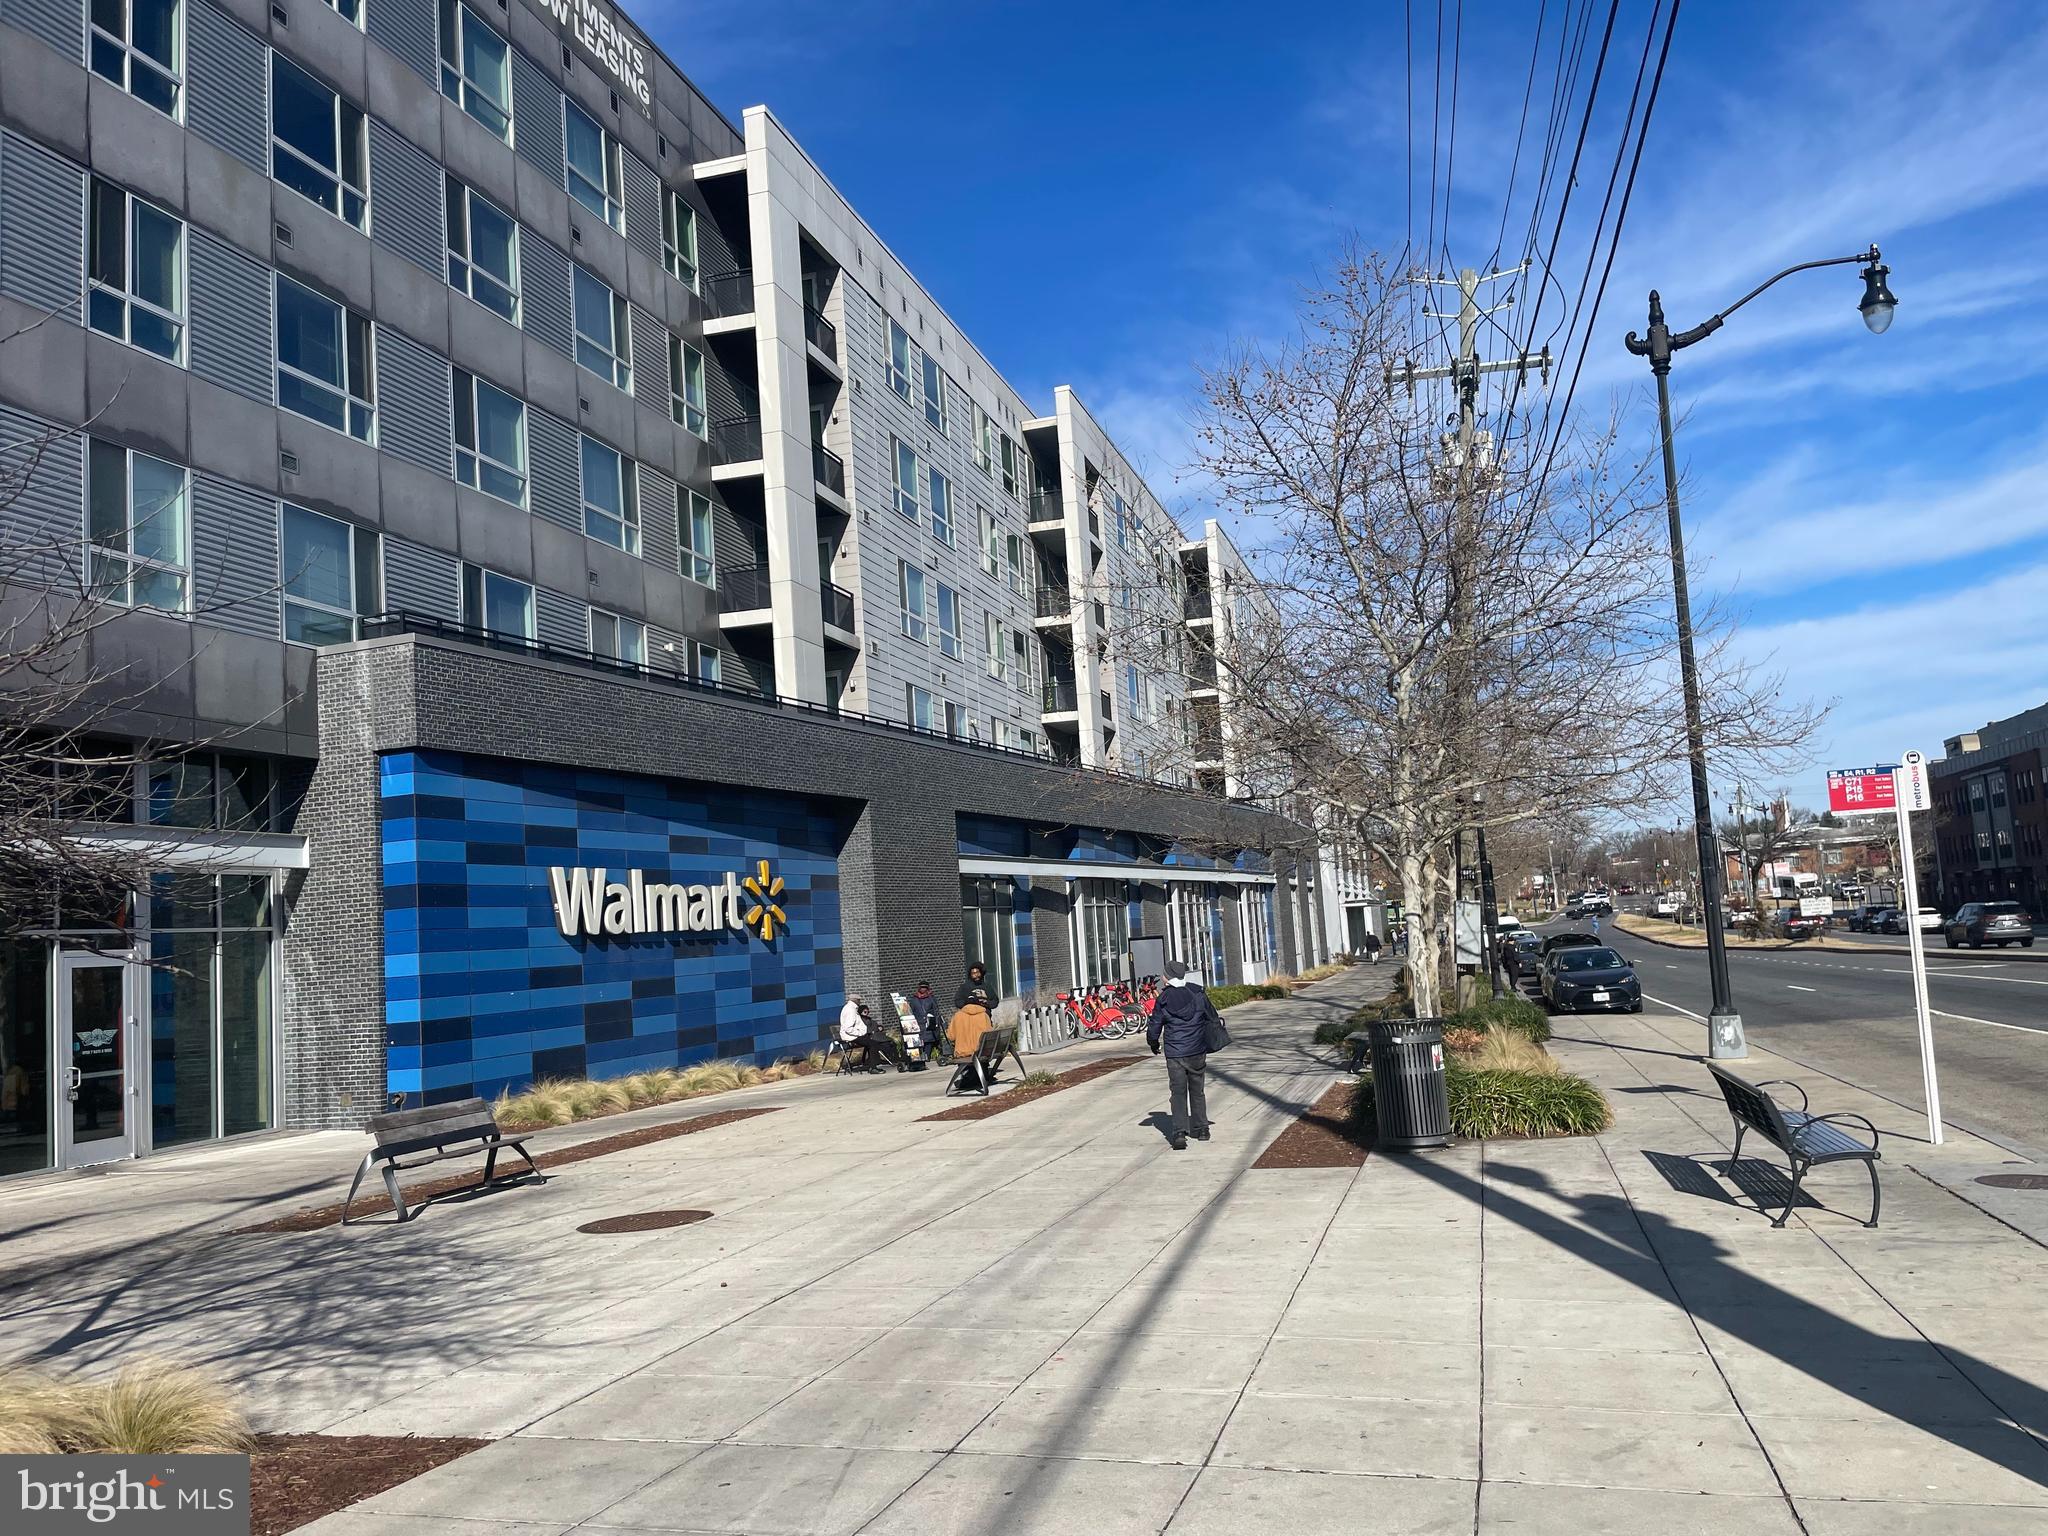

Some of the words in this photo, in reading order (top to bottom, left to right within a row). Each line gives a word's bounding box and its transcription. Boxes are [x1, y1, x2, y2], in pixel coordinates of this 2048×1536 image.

[573, 12, 650, 105] LEASING
[1845, 777, 1862, 785] C71
[1846, 785, 1863, 794] P15
[1912, 765, 1922, 808] metrobus
[1847, 794, 1864, 802] P16
[550, 866, 744, 936] Walmart
